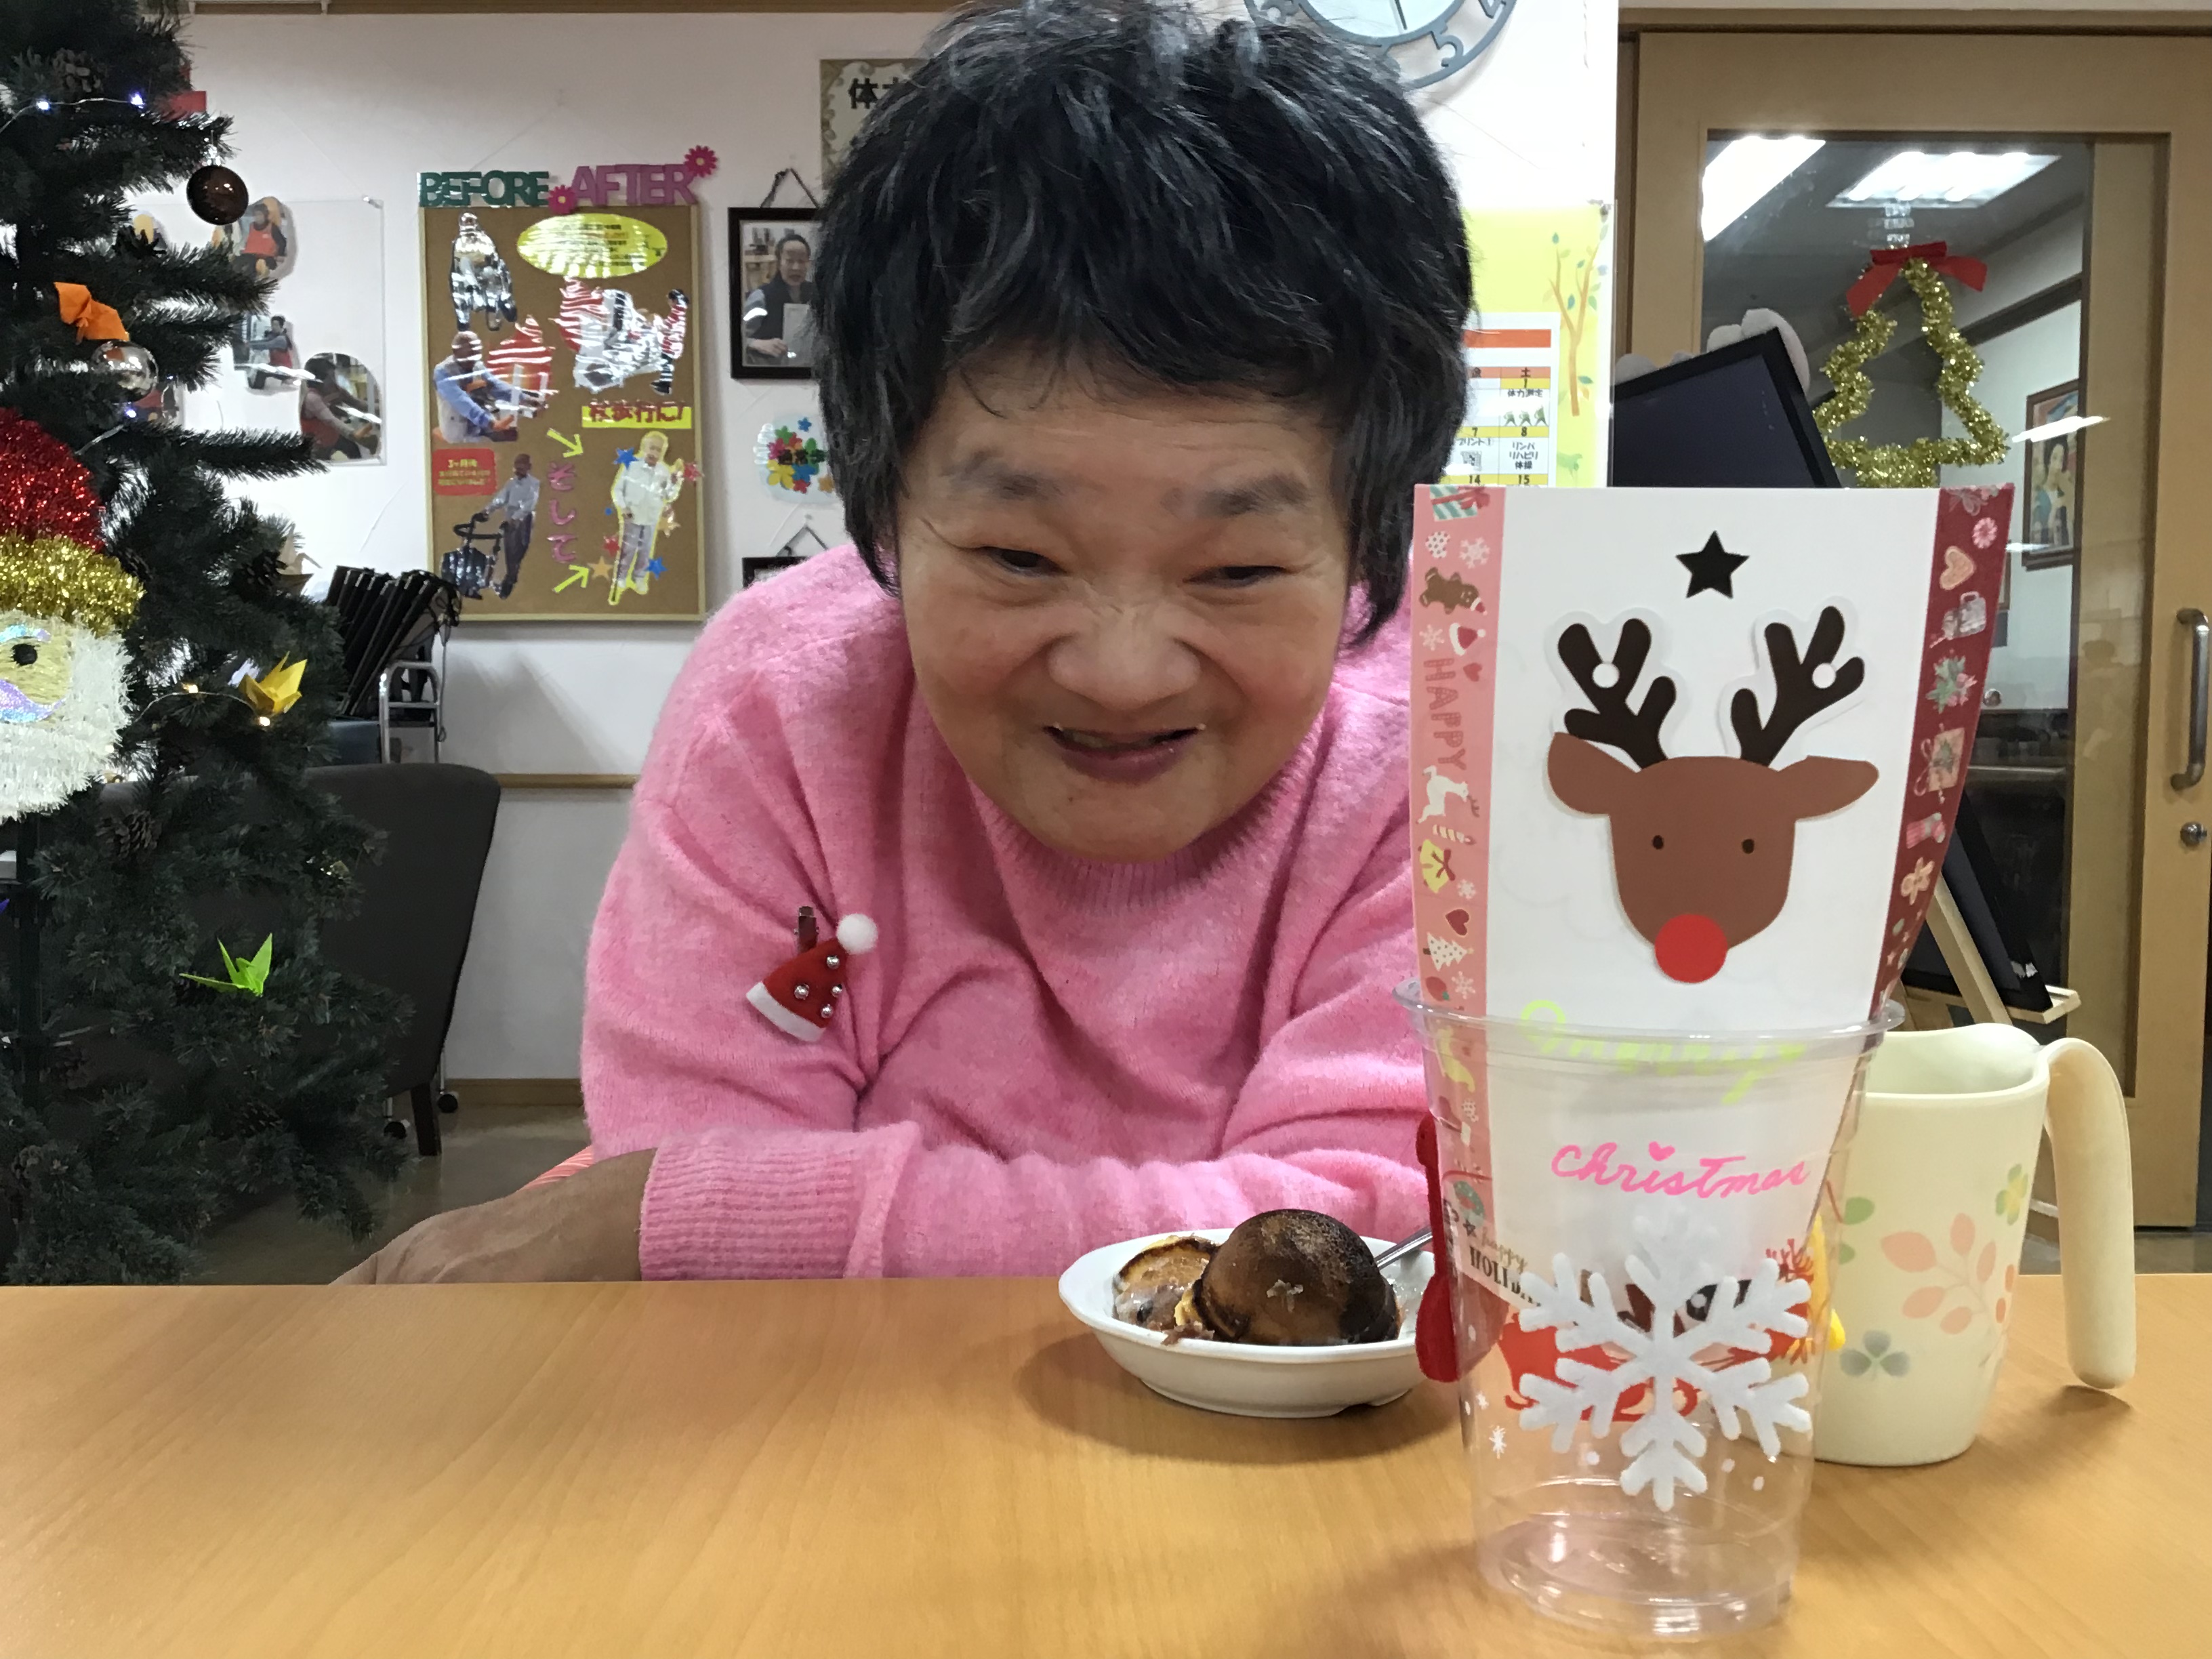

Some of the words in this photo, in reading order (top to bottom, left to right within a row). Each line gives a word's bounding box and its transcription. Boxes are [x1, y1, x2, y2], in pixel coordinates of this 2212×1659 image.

[418, 171, 550, 207] BEFORE
[571, 163, 697, 206] AFTER
[1521, 367, 1531, 377] 土
[1472, 427, 1478, 437] 7
[1521, 426, 1528, 437] 8
[1512, 441, 1535, 451] リンパ
[1509, 451, 1538, 460] リハビリ
[1469, 474, 1481, 485] 14
[1518, 474, 1530, 485] 15
[548, 462, 577, 563] そして
[1425, 658, 1466, 770] HAPPY
[1552, 1142, 1810, 1198] Christmas
